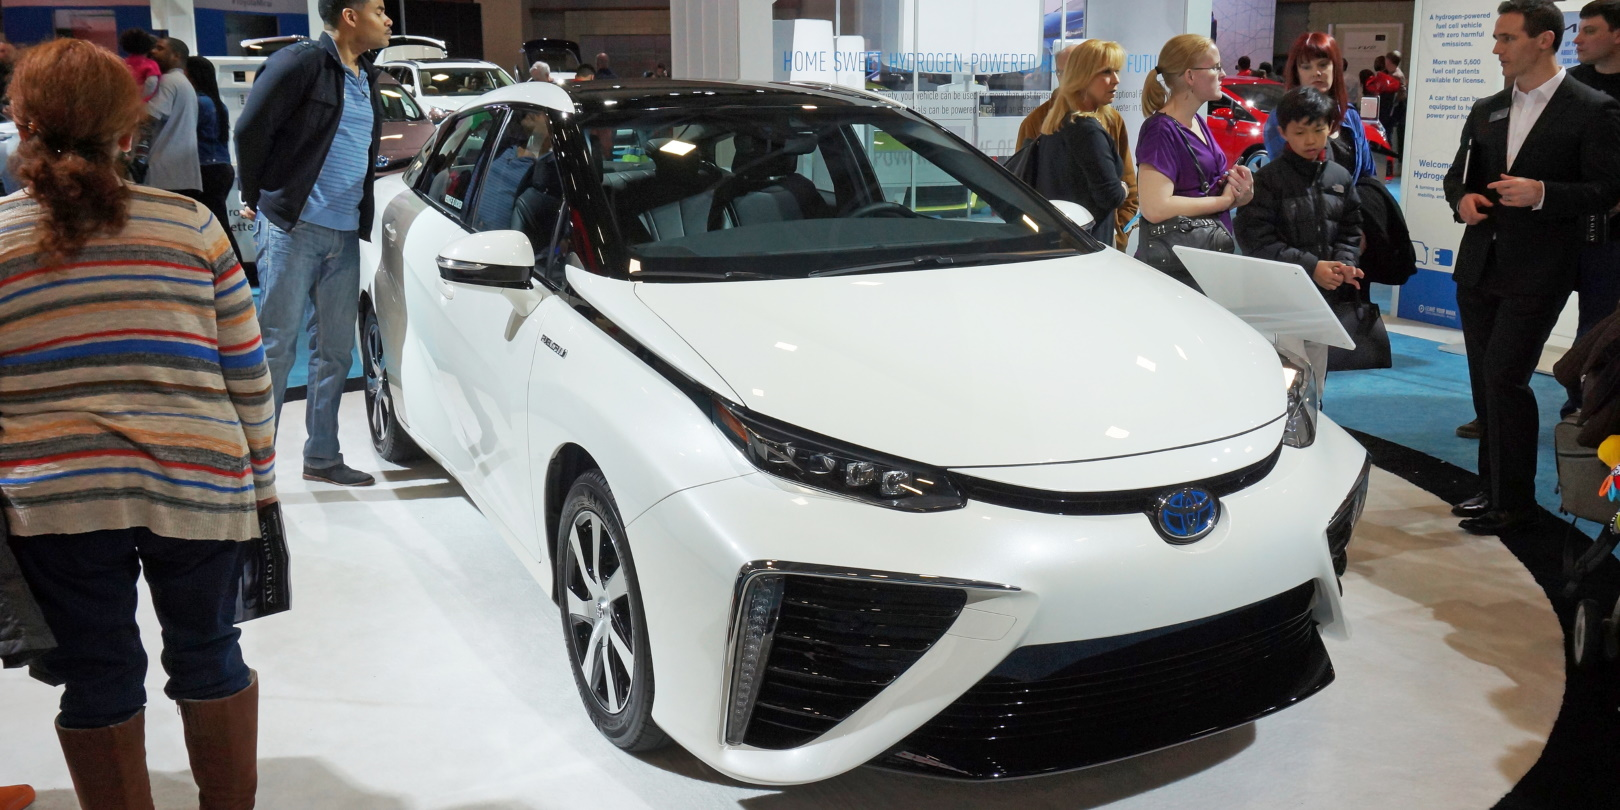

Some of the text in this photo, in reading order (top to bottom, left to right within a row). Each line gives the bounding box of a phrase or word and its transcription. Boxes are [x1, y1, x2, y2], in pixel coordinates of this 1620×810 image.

[1435, 12, 1491, 21] hydrogen-powered
[782, 51, 827, 72] HOME
[833, 51, 883, 72] SWEET
[889, 52, 1036, 73] HYDROGEN-POWERED
[916, 91, 939, 100] vehicle
[940, 92, 951, 100] can
[953, 91, 961, 100] be
[962, 91, 977, 100] used
[928, 106, 940, 115] can
[941, 105, 949, 115] be
[950, 105, 977, 117] powered
[260, 521, 274, 604] AUTO SHOW
